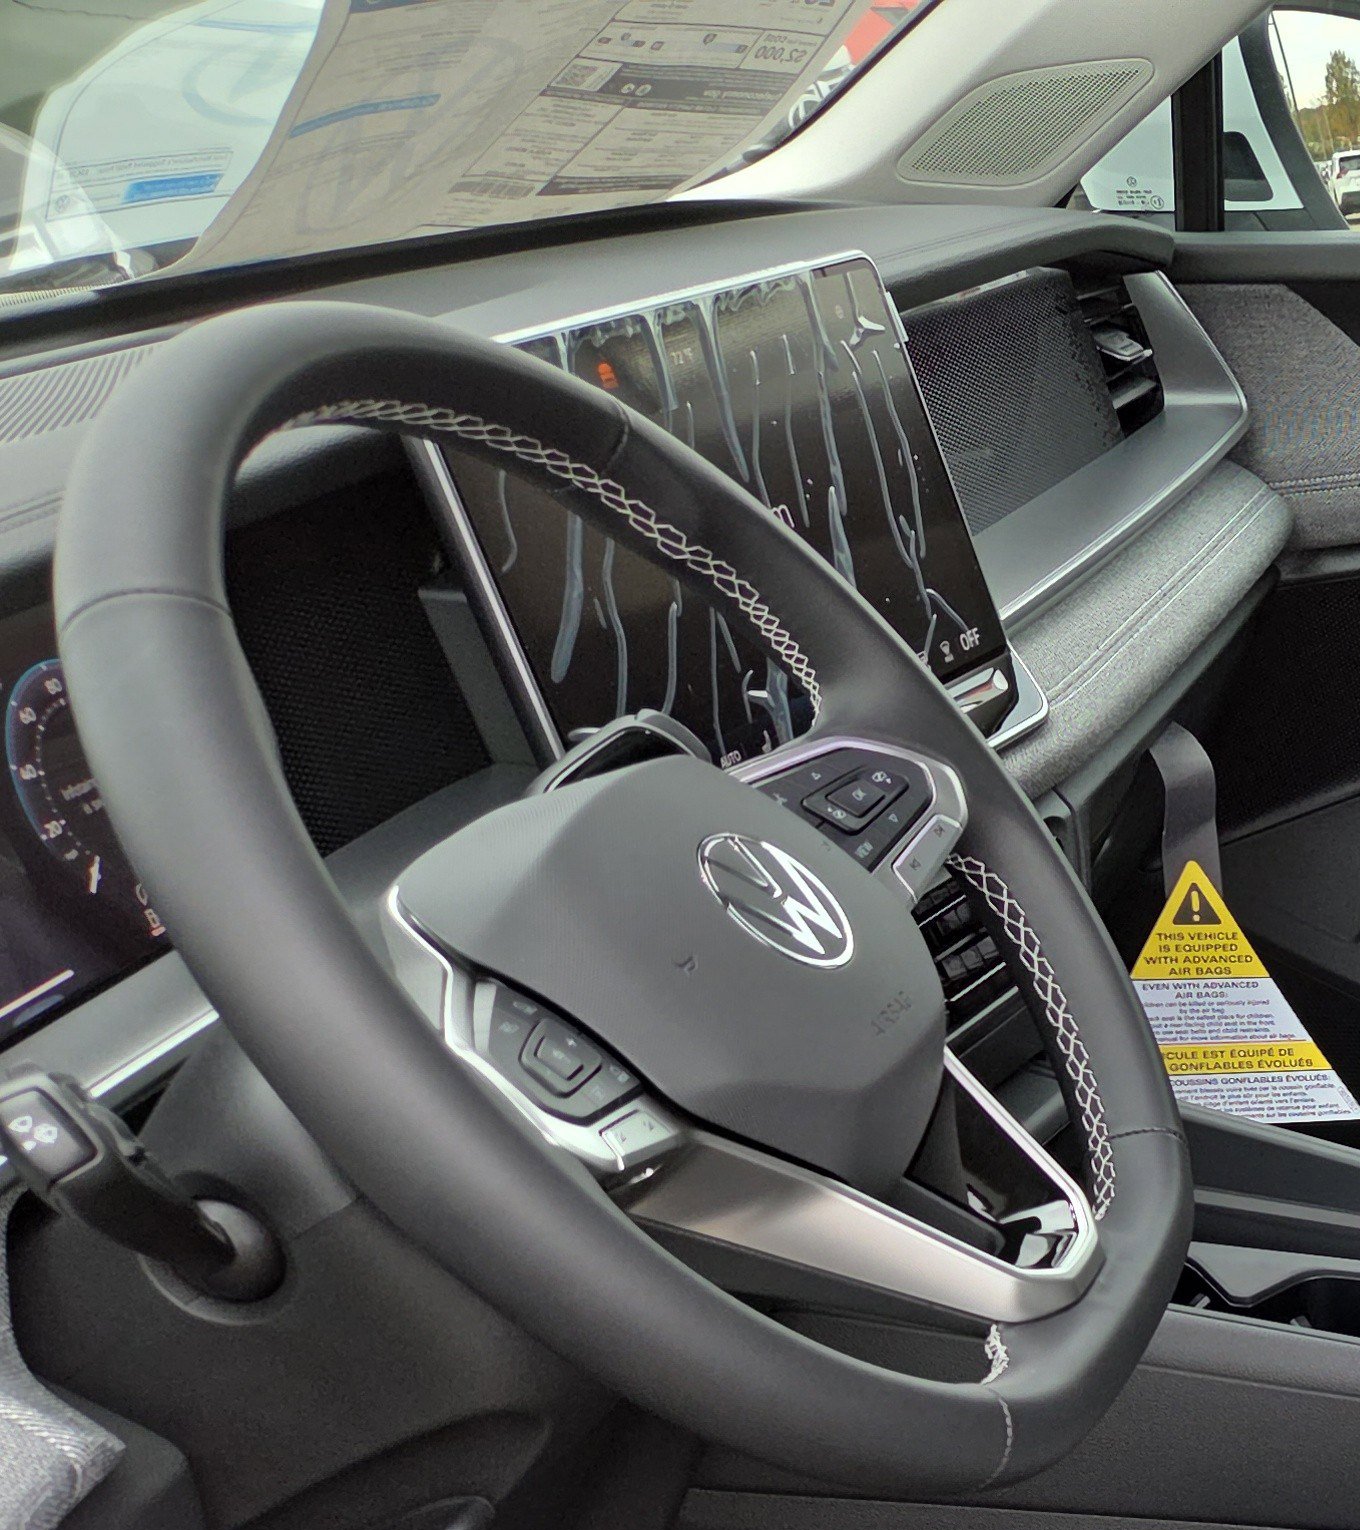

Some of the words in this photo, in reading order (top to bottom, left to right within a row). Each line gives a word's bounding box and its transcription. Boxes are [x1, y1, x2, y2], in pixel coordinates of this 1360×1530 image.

[960, 627, 980, 650] OFF
[720, 750, 742, 768] AUTO
[1156, 932, 1184, 941] THIS
[1188, 931, 1238, 941] VEHICLE
[1159, 944, 1171, 953] IS
[1175, 943, 1238, 953] EQUIPPED
[1144, 955, 1178, 965] WITH
[1183, 954, 1253, 964] ADVANCED
[1168, 967, 1191, 976] AIR
[1196, 966, 1231, 976] BAGS
[1142, 982, 1169, 991] EVEN
[1172, 981, 1200, 990] WITH
[1203, 980, 1259, 990] ADVANCED
[1175, 991, 1193, 999] AIR
[1165, 1050, 1198, 1061] CULE
[1202, 1049, 1226, 1059] EST
[1230, 1047, 1275, 1059] ÉQUIPÉ
[1278, 1047, 1294, 1057] DE
[1169, 1059, 1254, 1072] GONFLABLES
[1257, 1057, 1313, 1070] ÉVOLUÉS
[1220, 1075, 1284, 1085] GONFLABLES
